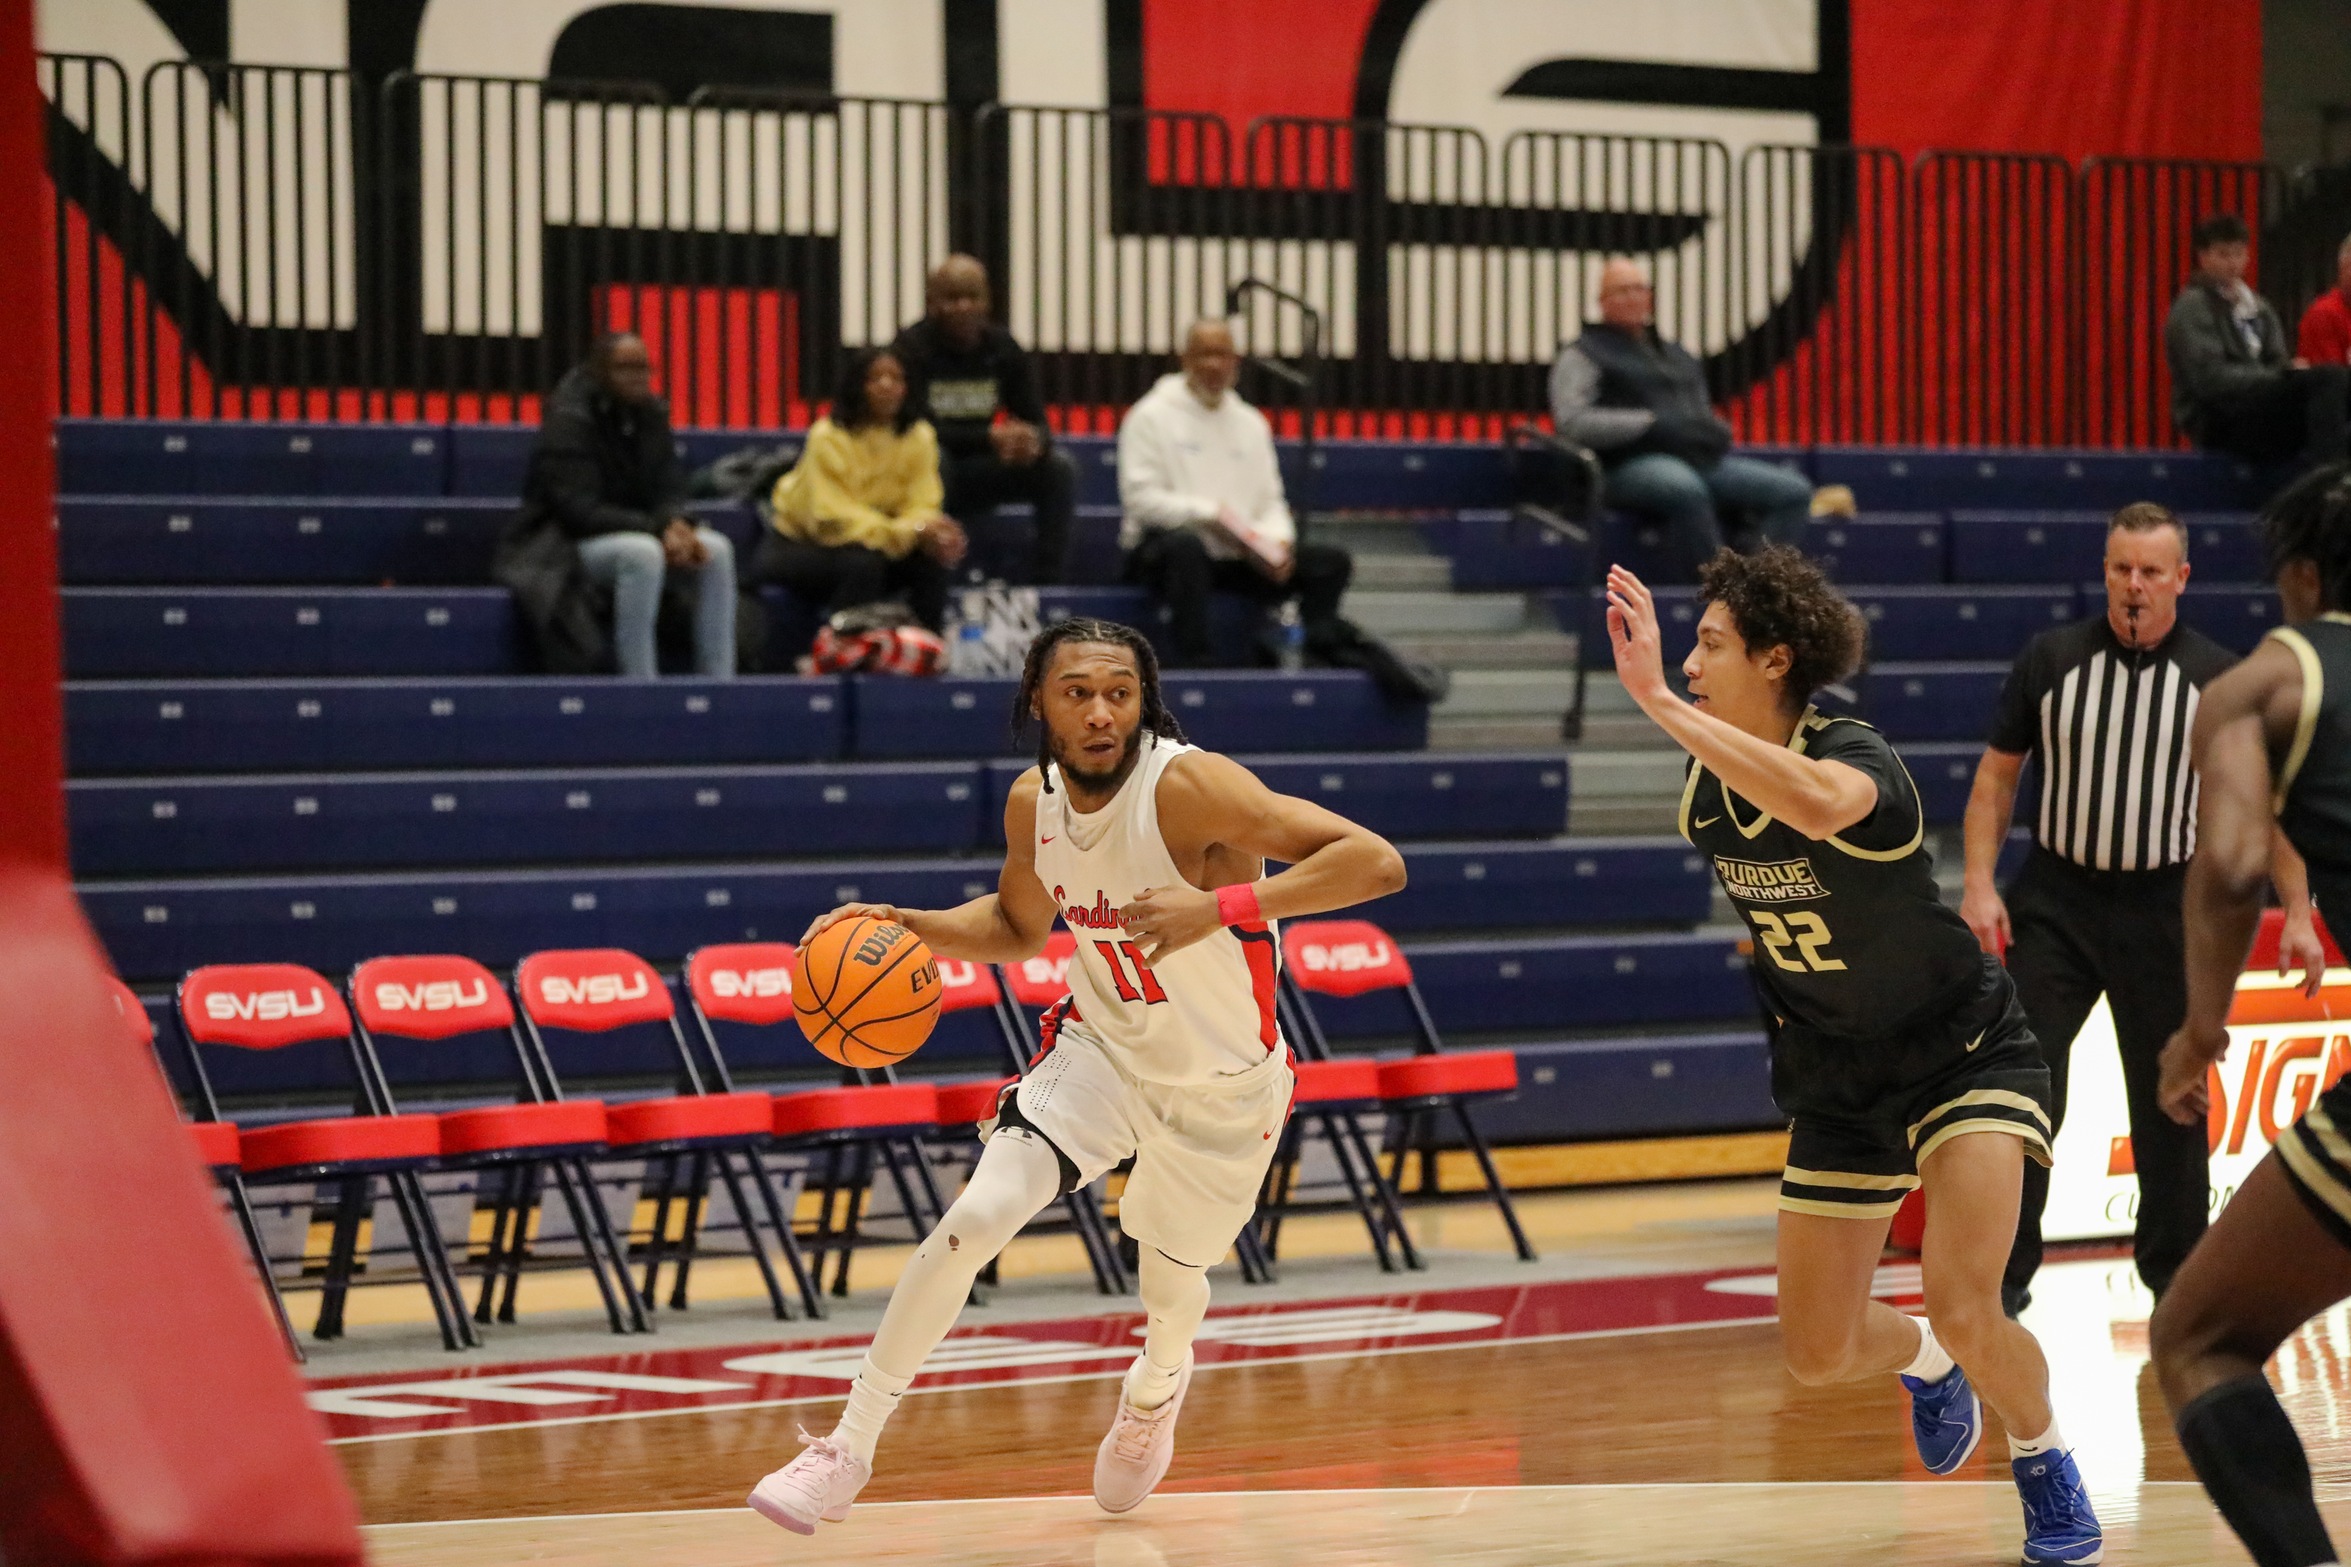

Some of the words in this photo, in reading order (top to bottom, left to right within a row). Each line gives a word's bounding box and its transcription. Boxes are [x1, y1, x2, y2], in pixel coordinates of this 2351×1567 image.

[1717, 861, 1811, 886] PURDUE
[1054, 885, 1148, 929] Cardin
[1727, 882, 1817, 900] NORTHWEST
[1301, 940, 1390, 971] SVSU
[1749, 911, 1848, 972] 22
[540, 970, 650, 1004] SVSU
[1093, 940, 1169, 1005] 11
[205, 986, 325, 1020] SVSU
[376, 978, 488, 1010] SVSU
